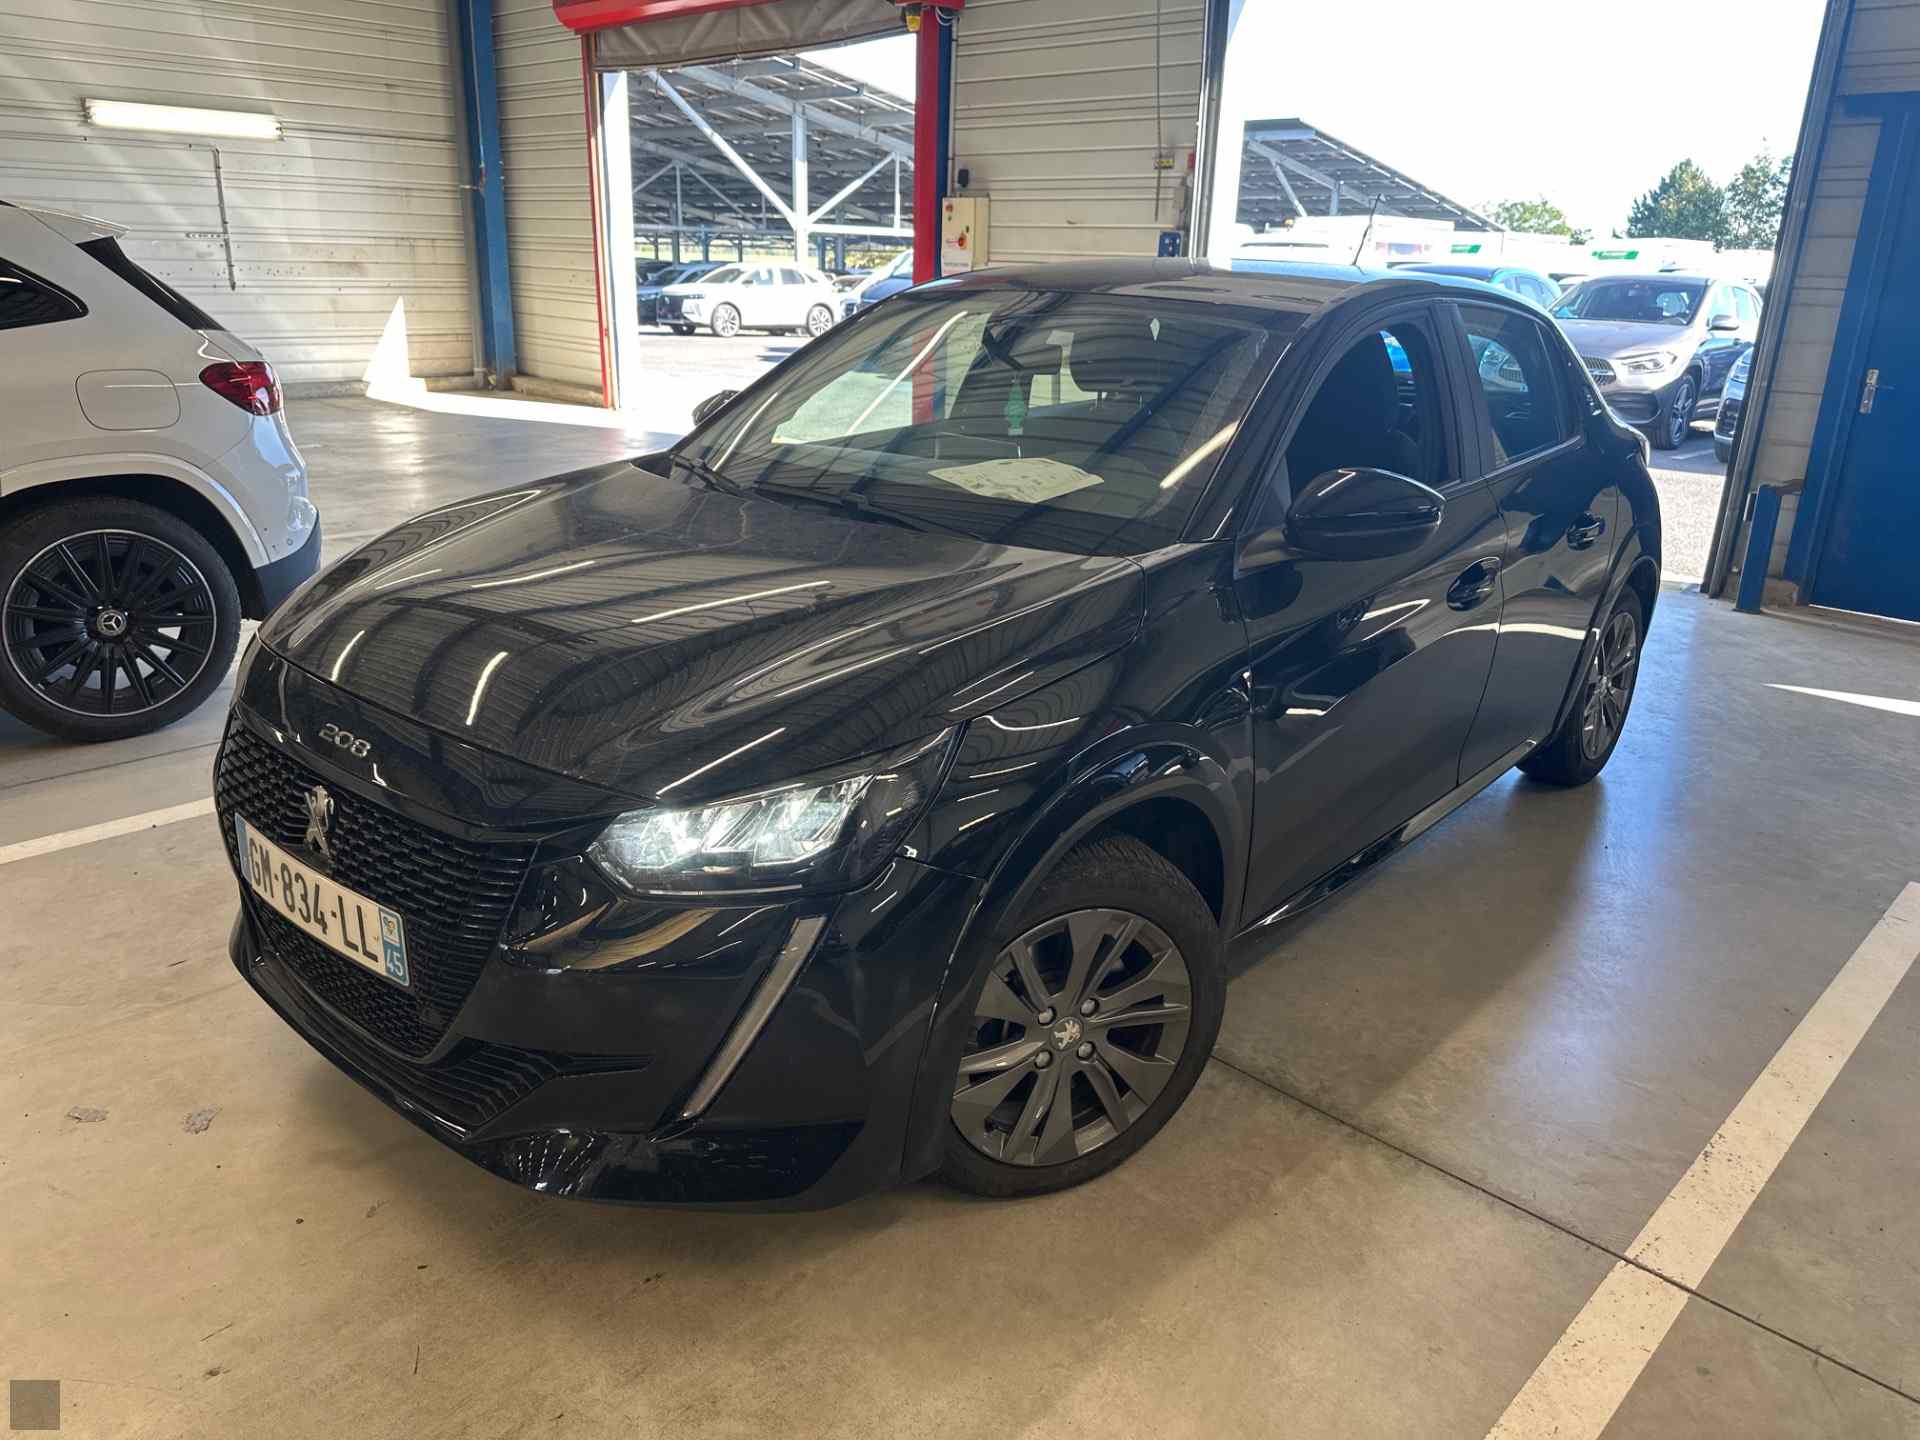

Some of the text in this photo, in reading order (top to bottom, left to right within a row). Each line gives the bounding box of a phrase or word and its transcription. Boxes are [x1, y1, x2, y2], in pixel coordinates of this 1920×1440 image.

[318, 723, 371, 757] 208
[249, 837, 378, 963] GM-834-LL
[386, 948, 404, 977] 45
